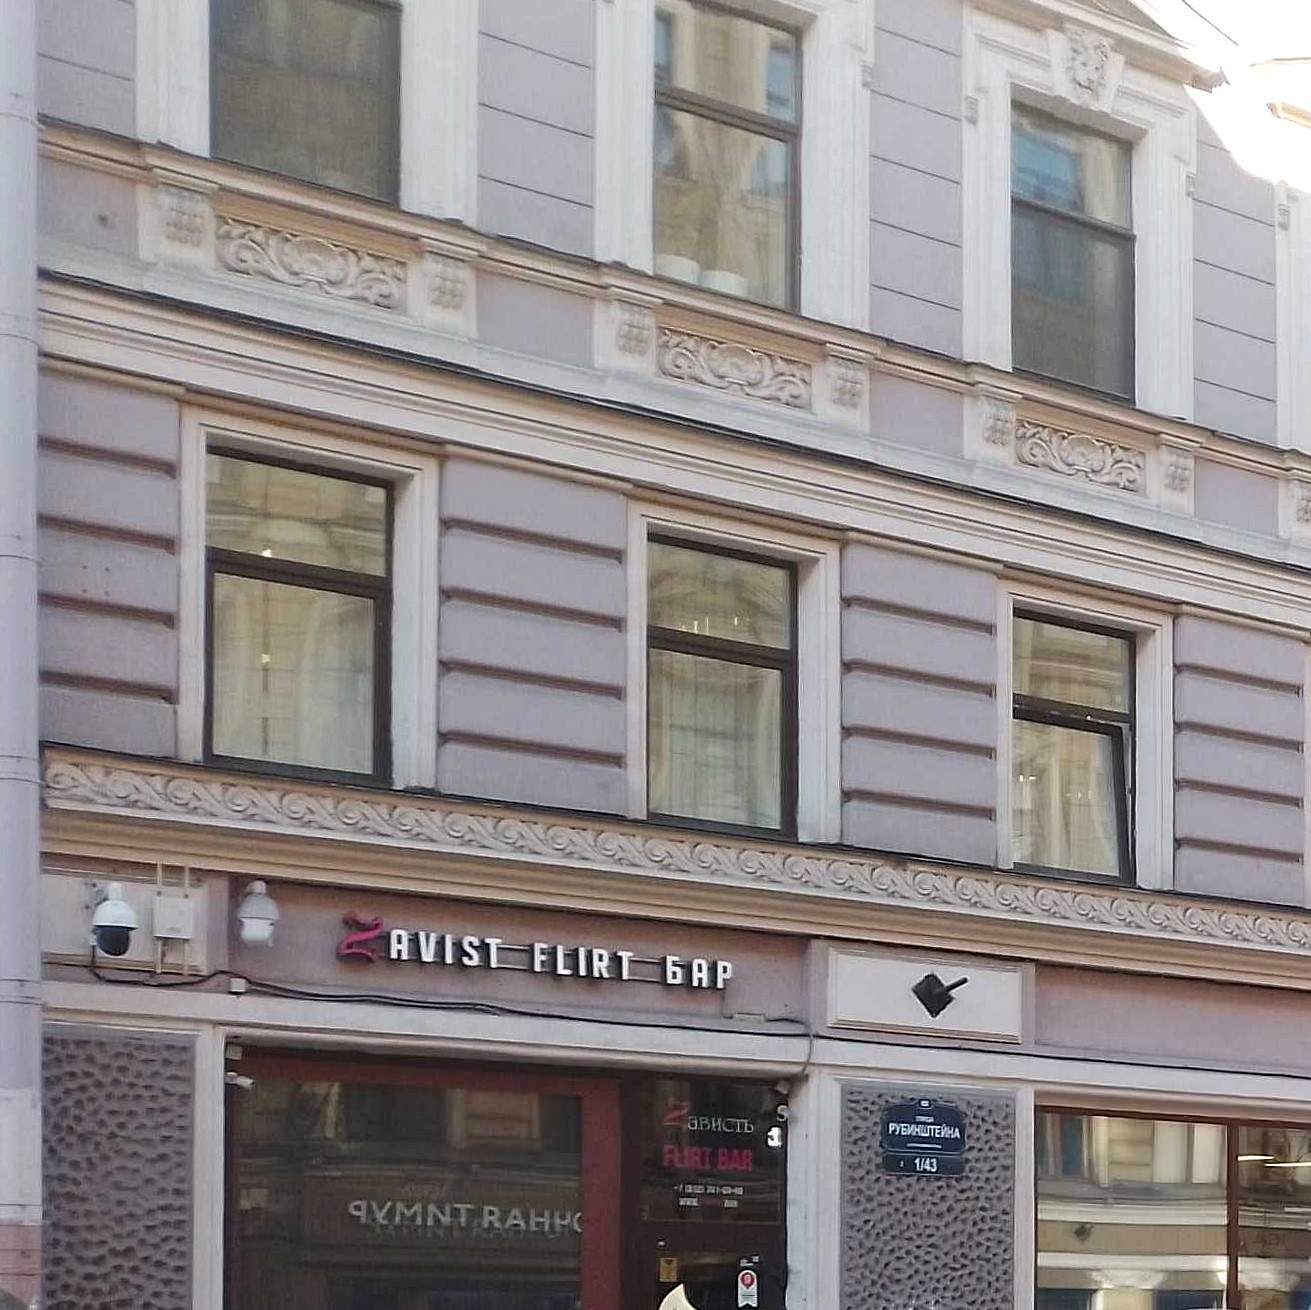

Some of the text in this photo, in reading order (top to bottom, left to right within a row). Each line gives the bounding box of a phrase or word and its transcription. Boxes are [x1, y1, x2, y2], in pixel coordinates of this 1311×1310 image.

[532, 942, 633, 981] FLIRT
[665, 955, 733, 989] БАР
[888, 1121, 961, 1139] РУБИНШТЕЙНА
[914, 1157, 938, 1173] 1/43
